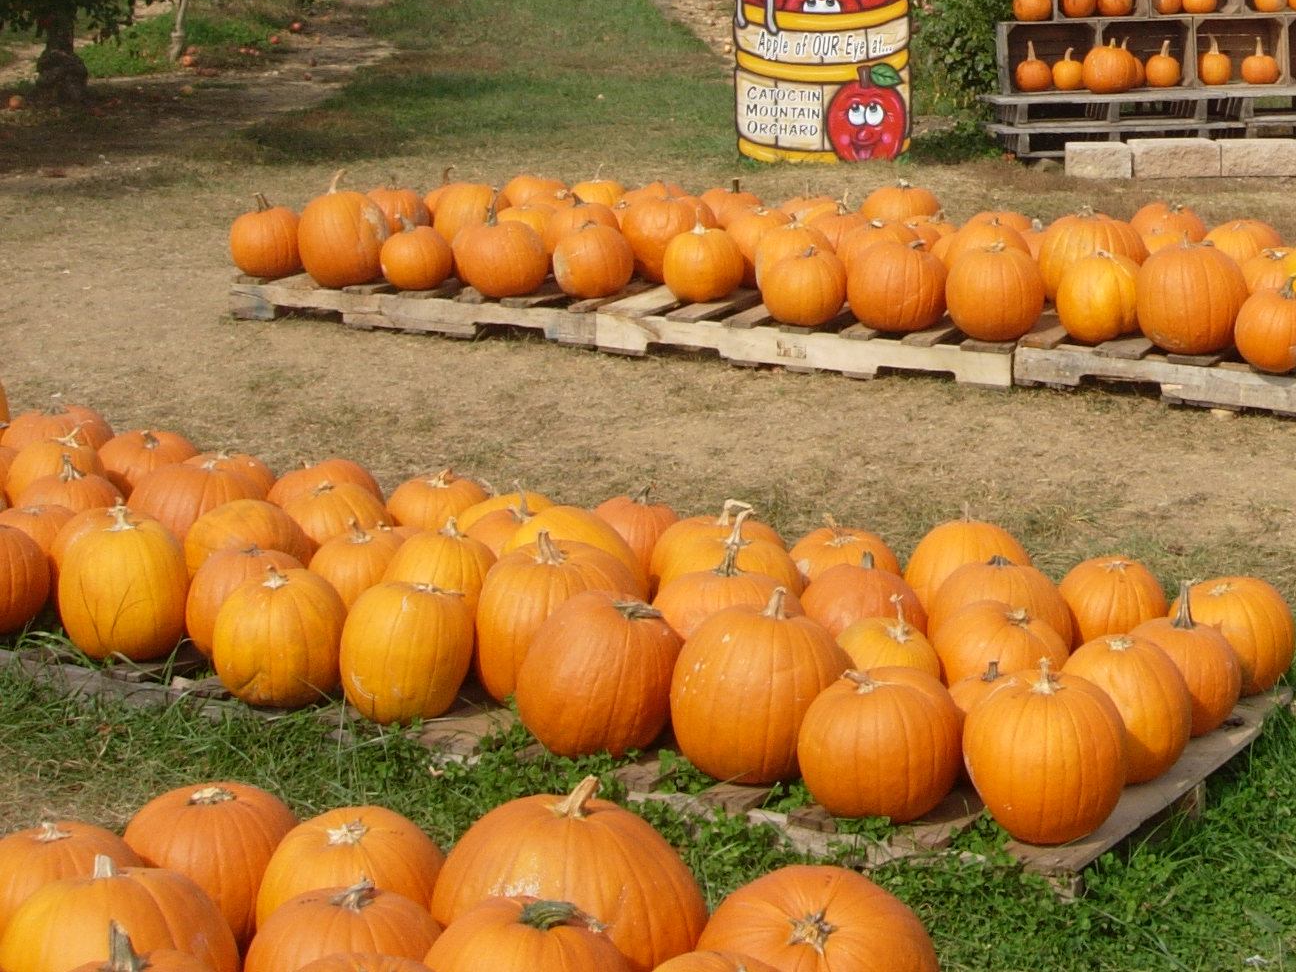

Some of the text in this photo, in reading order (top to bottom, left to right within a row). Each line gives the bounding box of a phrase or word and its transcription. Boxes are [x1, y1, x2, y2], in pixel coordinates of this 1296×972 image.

[757, 30, 789, 58] Apple
[795, 33, 808, 56] of
[812, 34, 840, 56] OUR
[845, 34, 866, 60] Eye
[746, 86, 821, 102] CATOCTIN
[746, 103, 820, 119] MOUNTAIN
[747, 120, 818, 136] ORCHARD
